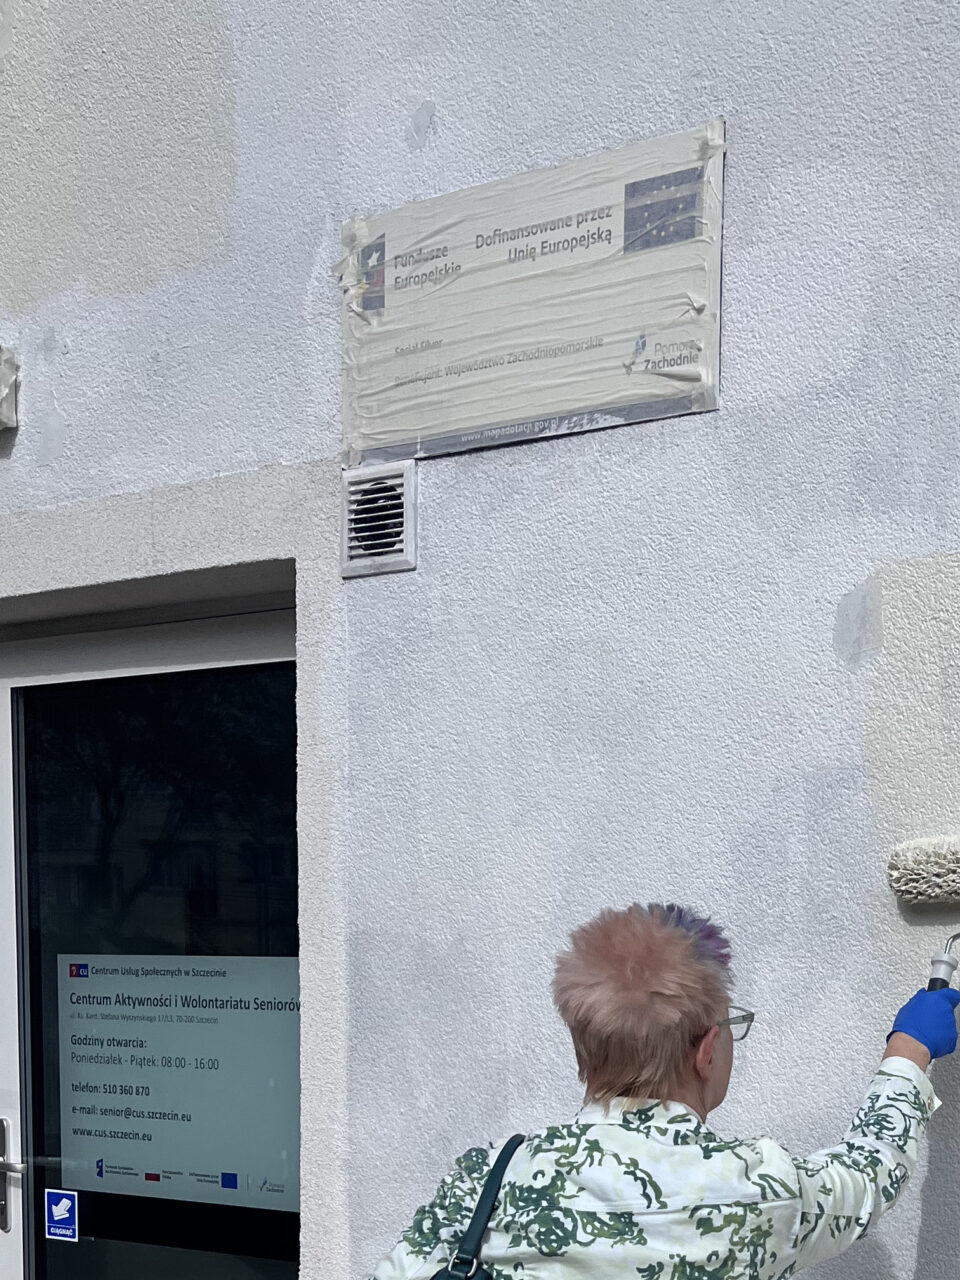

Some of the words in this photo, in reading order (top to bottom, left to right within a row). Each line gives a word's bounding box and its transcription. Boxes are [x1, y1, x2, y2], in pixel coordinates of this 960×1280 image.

[475, 214, 573, 249] Dofinansowane
[576, 206, 612, 229] przez
[508, 245, 536, 264] Unię
[539, 228, 612, 256] Europejską
[394, 244, 449, 270] Fundusze
[394, 262, 461, 291] Europejskie
[445, 356, 505, 377] Województwo
[506, 335, 604, 365] Zachodniopomorskie
[644, 351, 699, 371] Zachodnie
[91, 966, 120, 976] Centrum
[120, 966, 140, 978] Usług
[140, 966, 183, 979] Społecznych
[183, 968, 191, 977] w
[191, 967, 227, 978] Szczecinie
[70, 992, 112, 1006] Centrum
[114, 992, 172, 1010] Aktywności
[174, 994, 178, 1008] i
[180, 994, 251, 1010] Wolontariatu
[70, 1034, 104, 1049] Godziny
[106, 1036, 147, 1048] otwarcia:
[71, 1051, 123, 1065] Poniedziałek
[130, 1054, 159, 1069] Piątek:
[160, 1055, 186, 1069] 08:00
[194, 1057, 220, 1070] 16:00
[71, 1082, 101, 1094] telefon:
[102, 1083, 117, 1095] 510
[119, 1084, 134, 1096] 360
[135, 1085, 150, 1097] 870
[71, 1104, 98, 1116] e-mail:
[99, 1107, 192, 1122] senior@cus.szczecin.eu
[72, 1127, 152, 1142] www.cus.szczecin.eu
